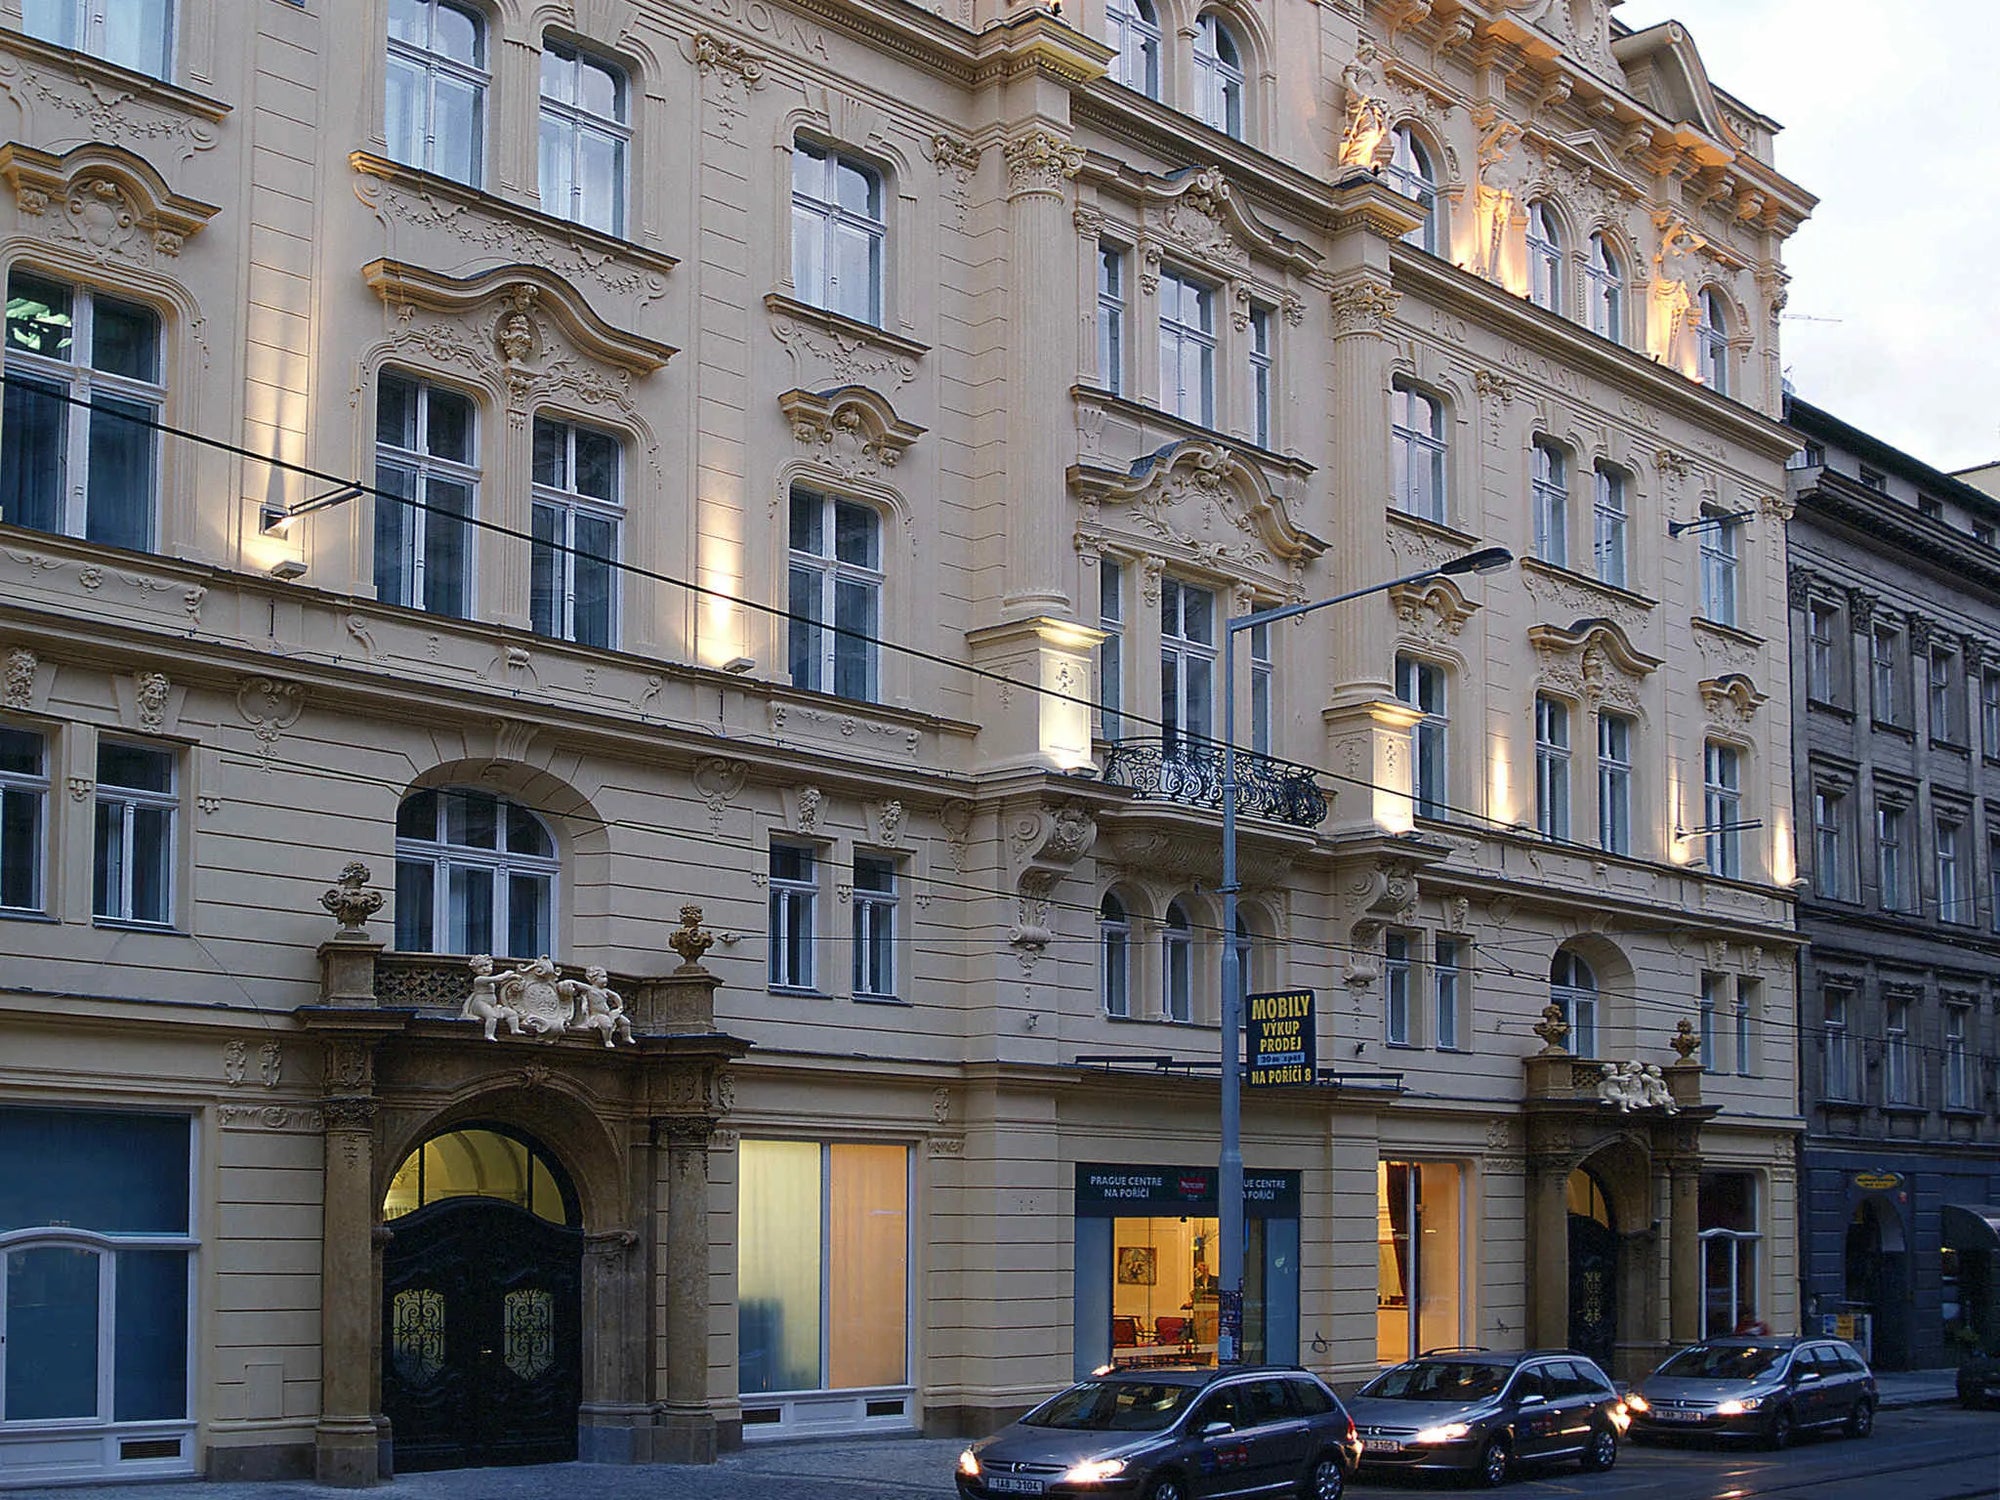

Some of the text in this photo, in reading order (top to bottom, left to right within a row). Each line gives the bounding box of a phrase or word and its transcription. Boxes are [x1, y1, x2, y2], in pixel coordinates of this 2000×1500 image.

[1252, 995, 1310, 1020] MOBILY
[1262, 1019, 1300, 1036] VÝKUP
[1260, 1037, 1302, 1052] PRODEJ
[1251, 1065, 1312, 1084] NA POŘÍČÍ 8
[1090, 1176, 1163, 1186] PRAGUE CENTRE
[1255, 1179, 1286, 1189] CENTRE
[1104, 1188, 1118, 1198] NA
